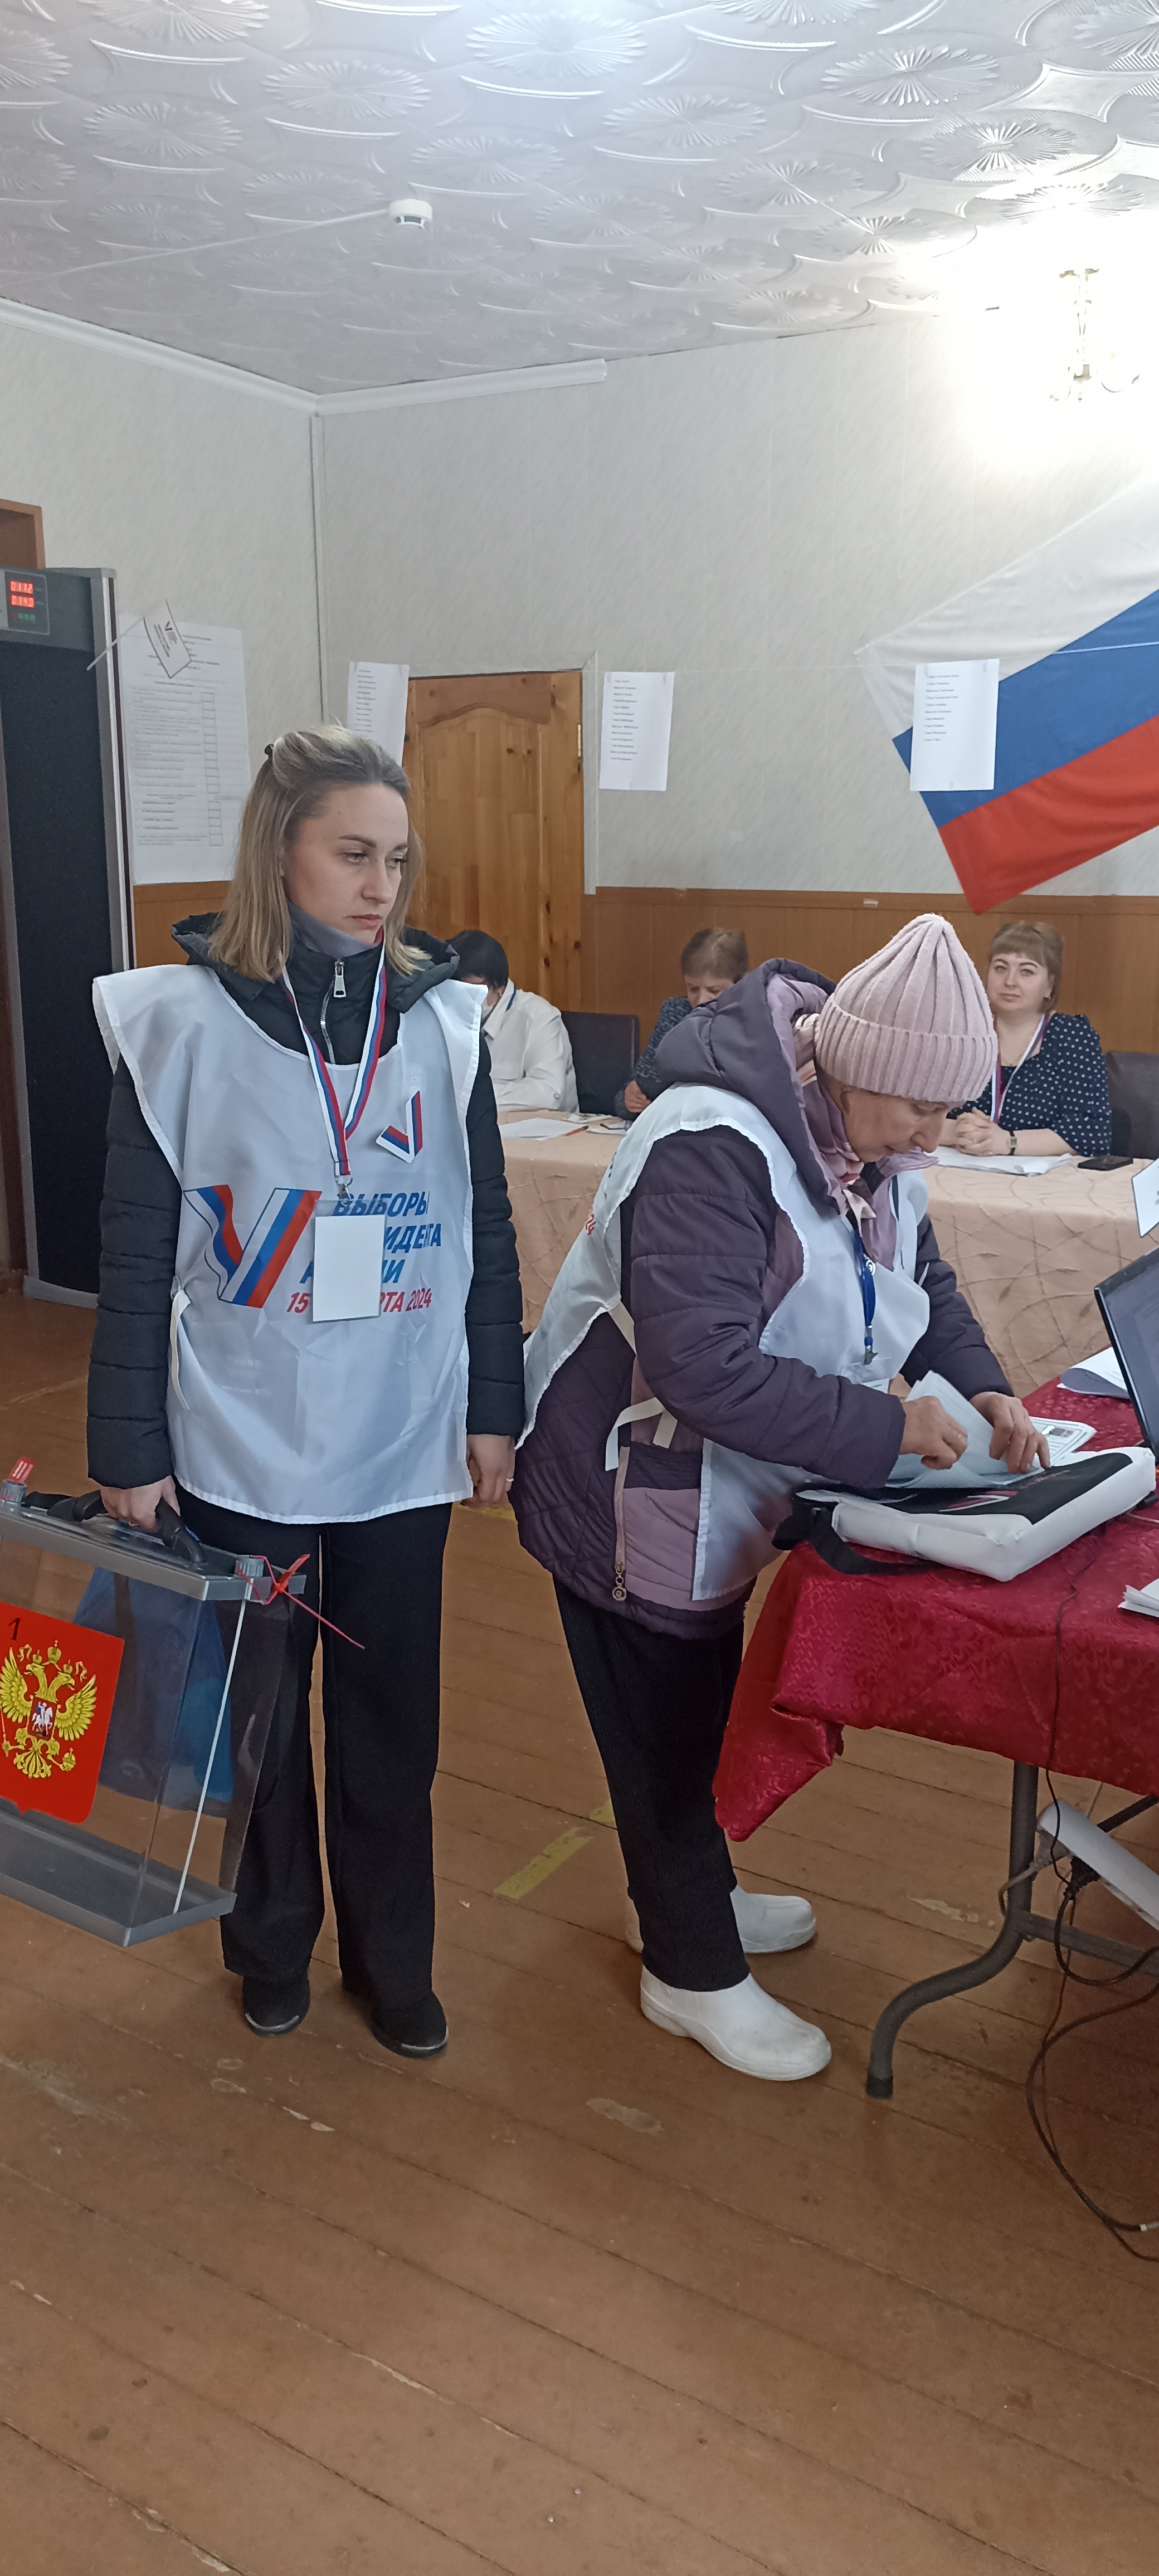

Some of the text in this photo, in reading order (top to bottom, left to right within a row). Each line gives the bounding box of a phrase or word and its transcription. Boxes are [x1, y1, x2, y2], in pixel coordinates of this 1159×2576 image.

[333, 1191, 430, 1217] ВЫБОРЫ
[406, 1287, 432, 1311] 2024
[8, 1617, 22, 1641] 1
